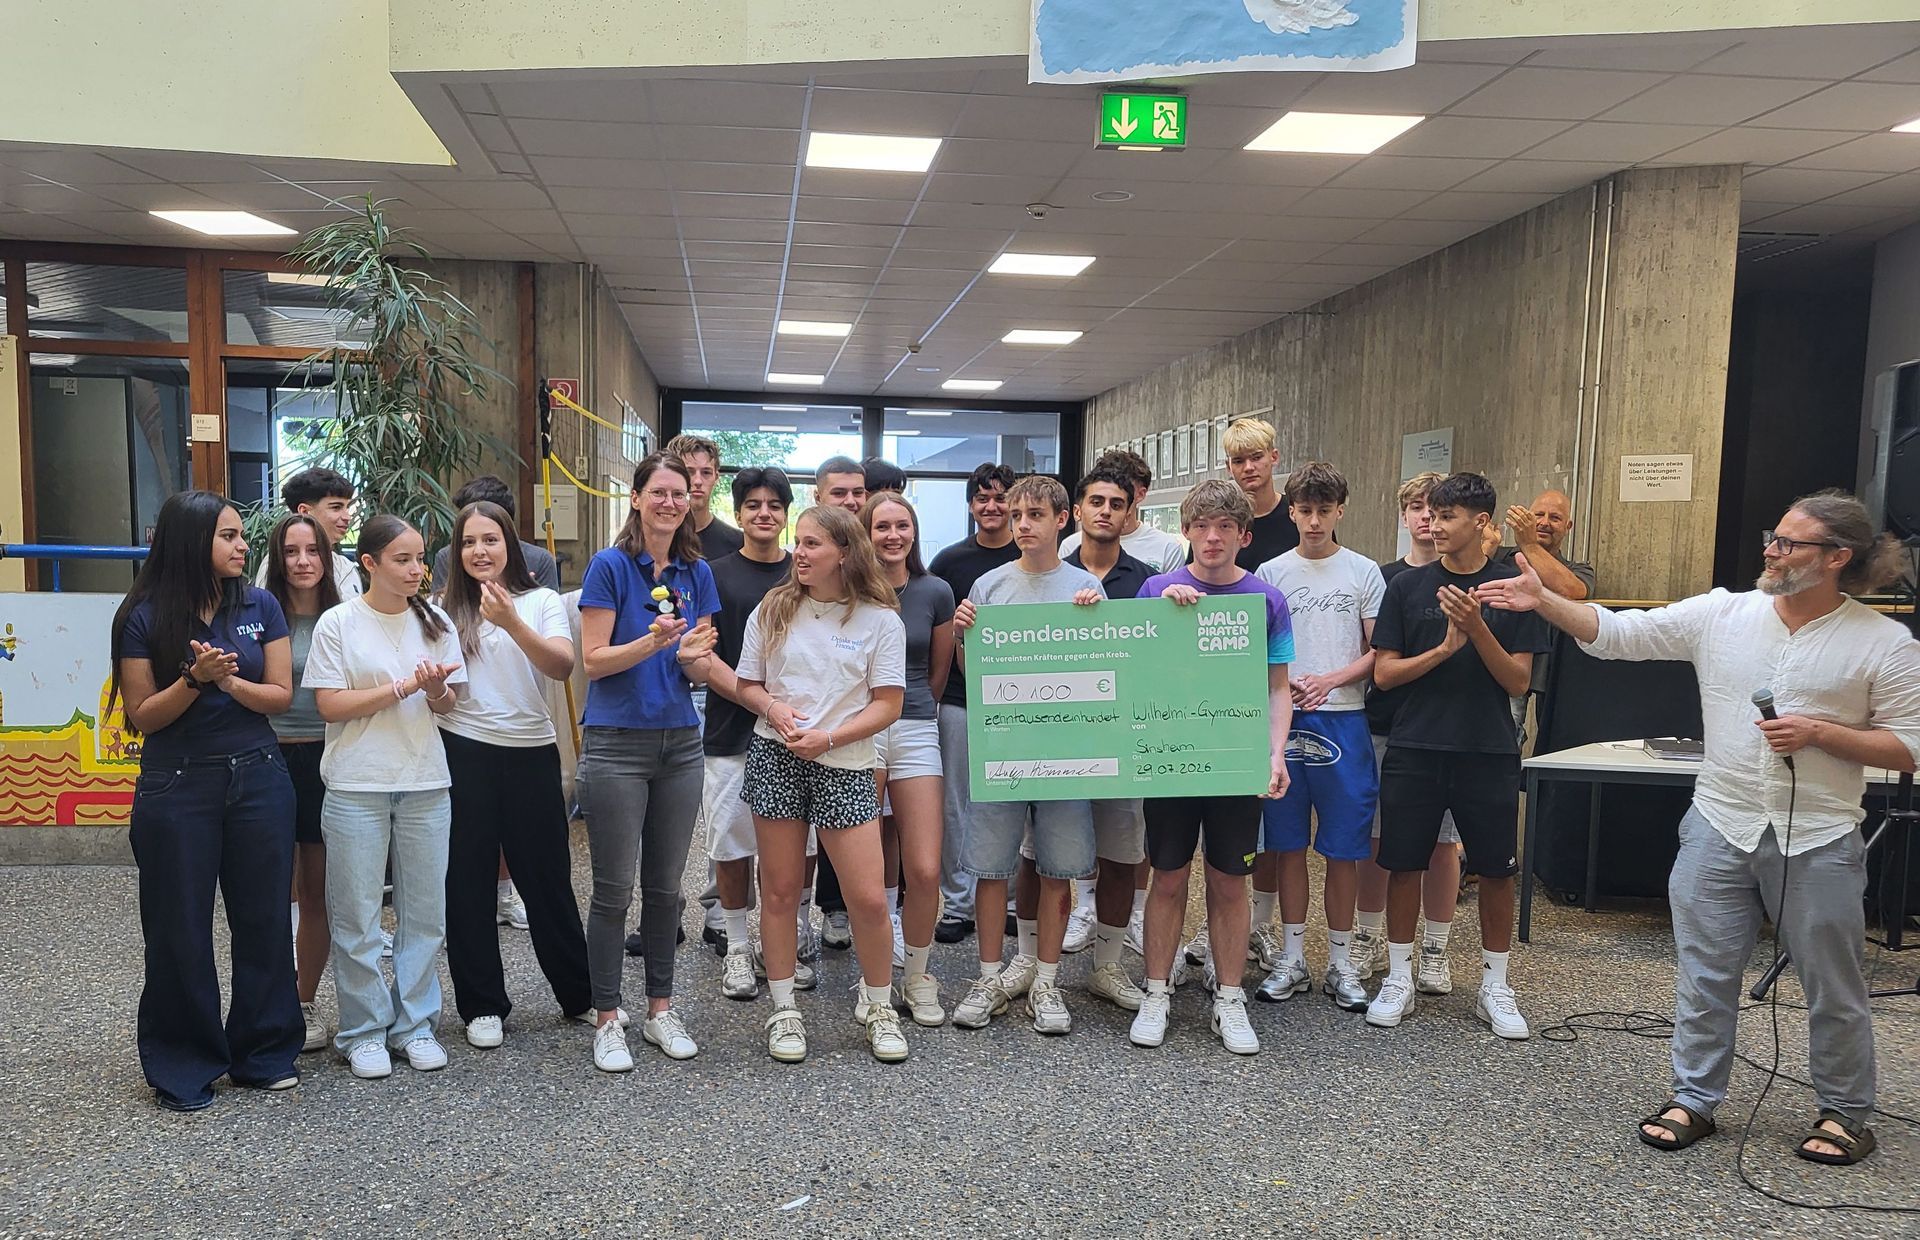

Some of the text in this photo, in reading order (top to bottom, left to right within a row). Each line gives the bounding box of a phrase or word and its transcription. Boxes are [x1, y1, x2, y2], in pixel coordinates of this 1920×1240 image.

[1197, 610, 1249, 626] WALD
[981, 620, 1159, 648] Spendenscheck
[1197, 625, 1249, 637] PIRATEN
[1197, 635, 1250, 651] CAMP
[981, 650, 1132, 663] Mit vereinten Kräften gegen den Krebs.
[1096, 678, 1111, 693] €
